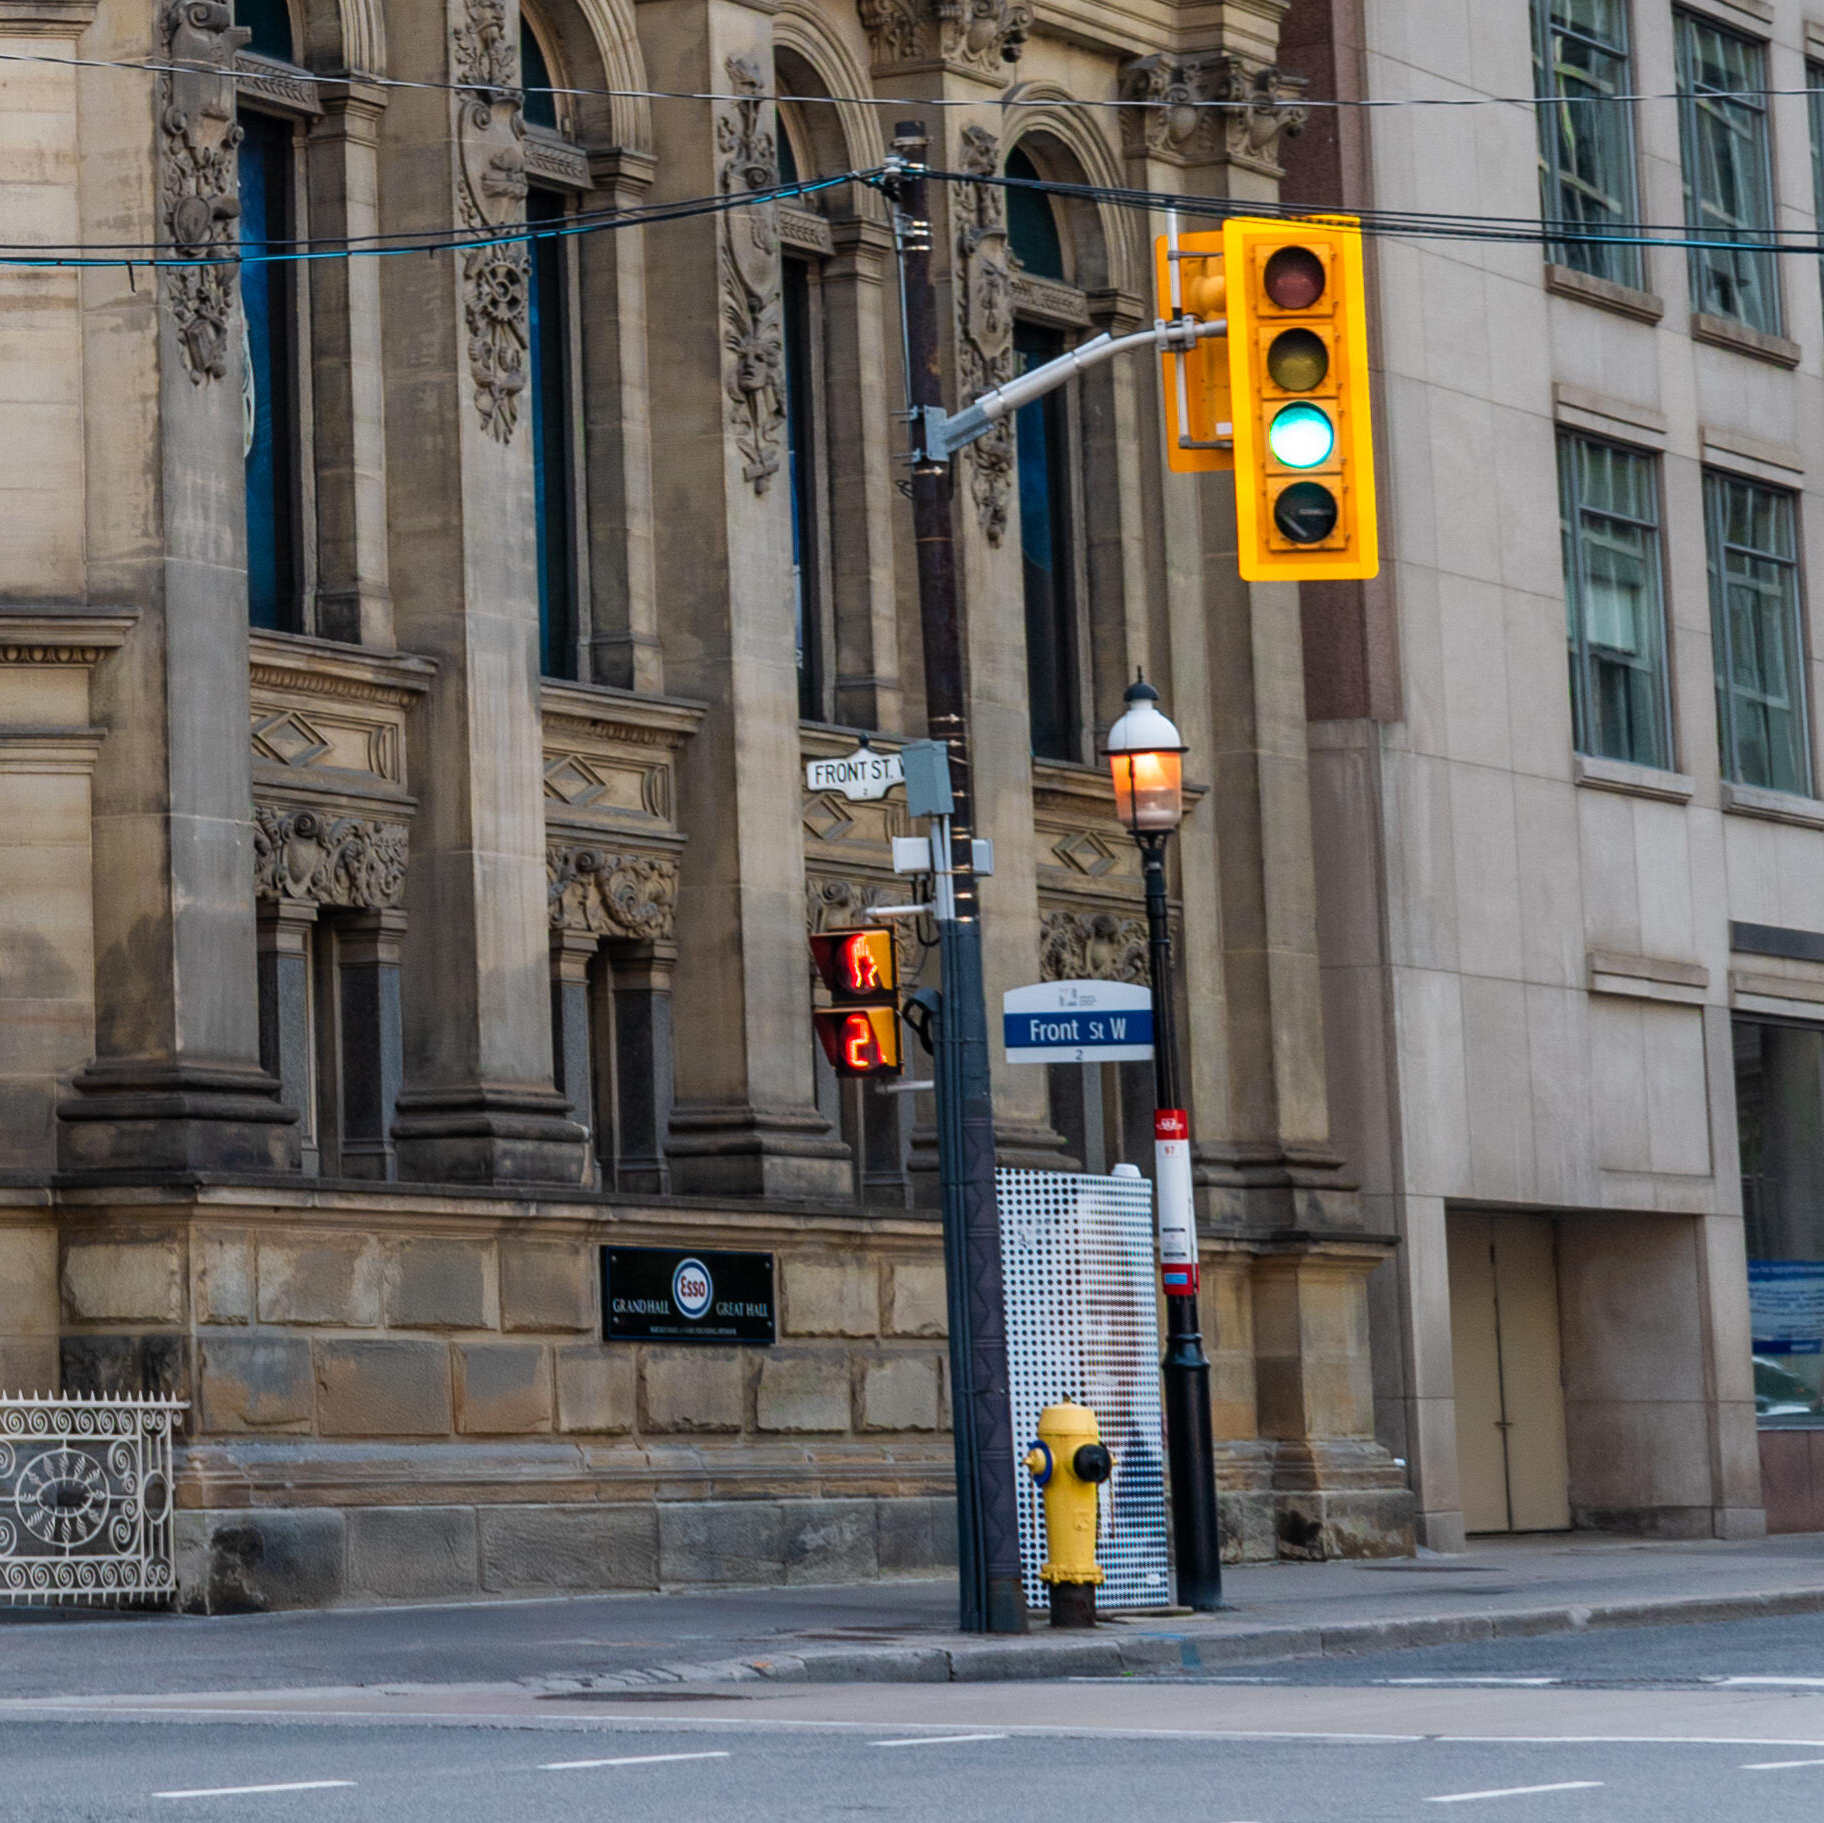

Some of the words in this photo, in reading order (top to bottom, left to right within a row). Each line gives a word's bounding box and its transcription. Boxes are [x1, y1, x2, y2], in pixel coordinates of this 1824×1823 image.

[815, 761, 867, 785] FRONT
[1030, 1019, 1080, 1041] Front
[1089, 1021, 1105, 1040] St
[1109, 1017, 1126, 1040] W
[1075, 1049, 1084, 1061] 2
[680, 1276, 706, 1298] Esso
[612, 1298, 647, 1315] GRAND
[647, 1300, 670, 1315] HALL
[716, 1301, 744, 1316] GREAT
[746, 1303, 769, 1318] HALL
